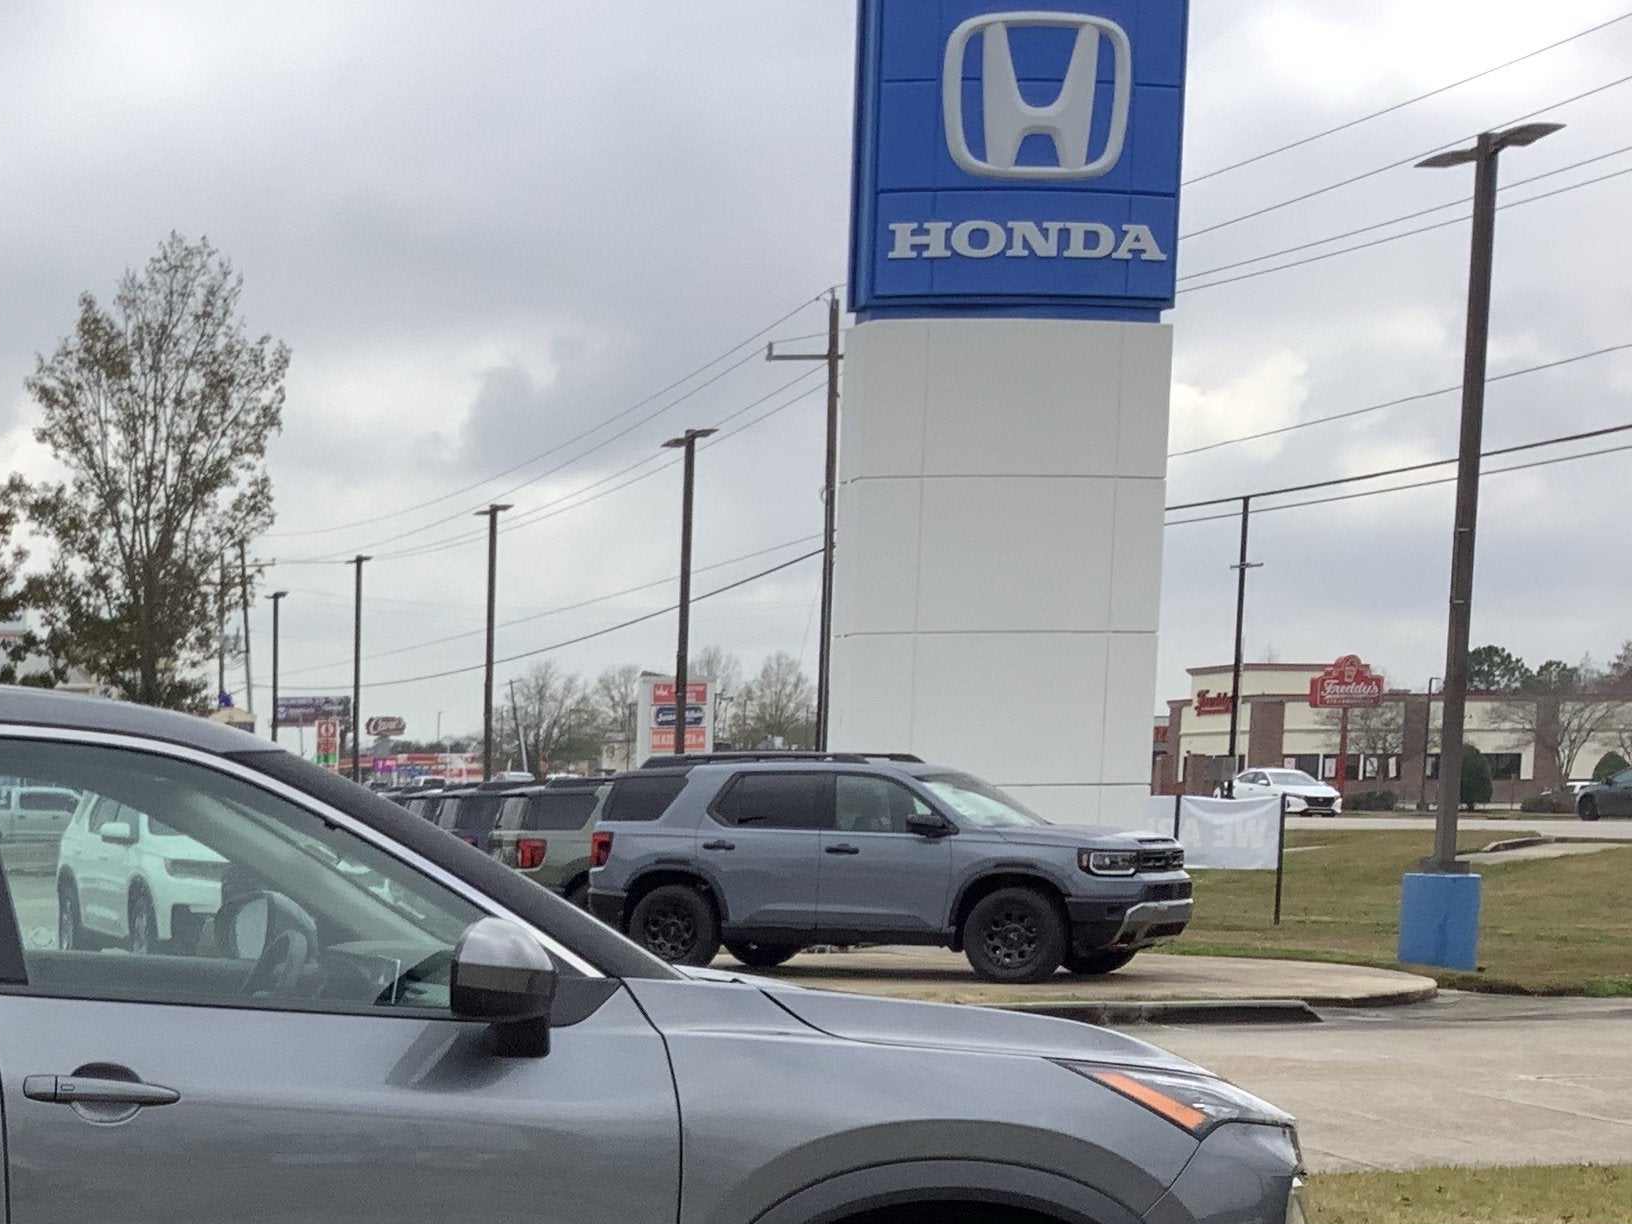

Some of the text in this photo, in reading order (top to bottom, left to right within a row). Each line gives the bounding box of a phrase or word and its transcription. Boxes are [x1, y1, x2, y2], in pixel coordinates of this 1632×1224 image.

[887, 220, 1167, 261] HONDA
[1320, 679, 1380, 697] Freddy's
[369, 716, 406, 734] Cane's
